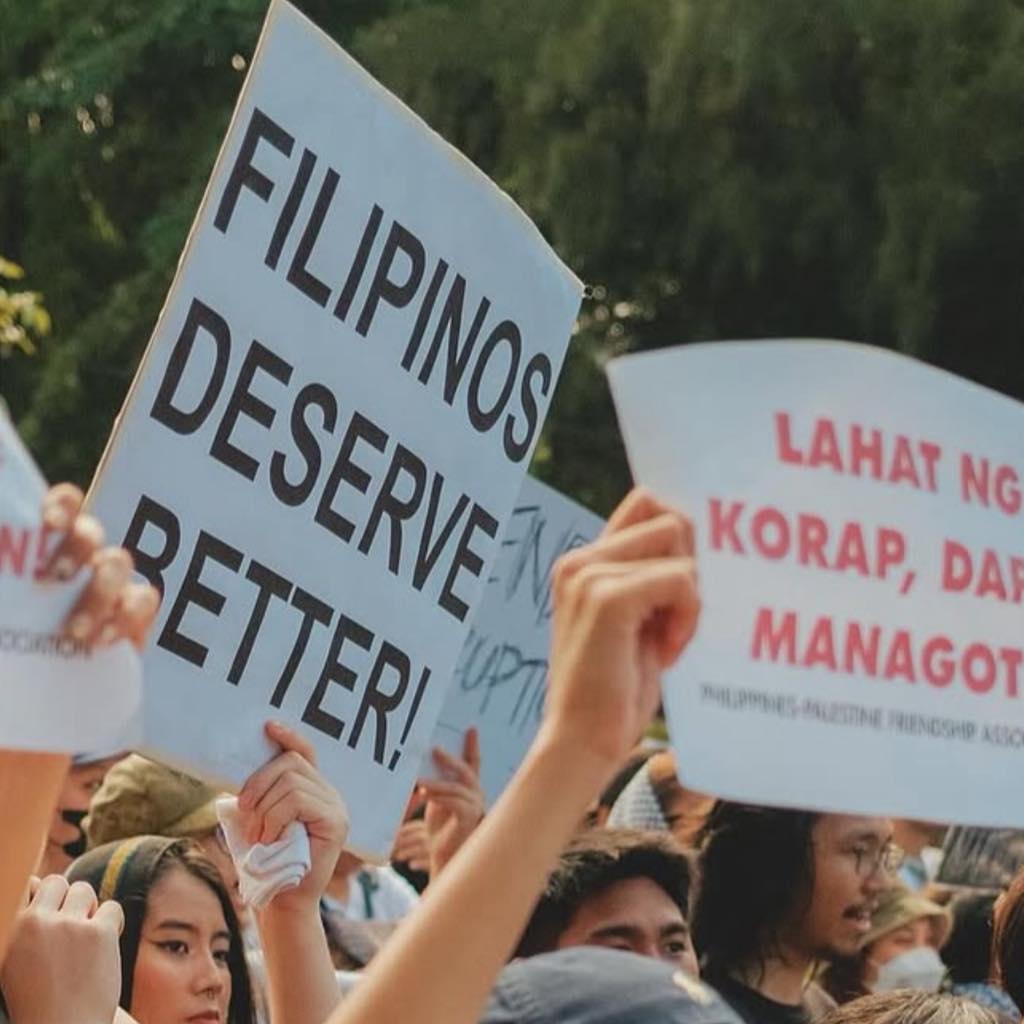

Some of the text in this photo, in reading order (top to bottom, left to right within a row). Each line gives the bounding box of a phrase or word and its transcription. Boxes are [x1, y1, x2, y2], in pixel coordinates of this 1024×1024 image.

[212, 107, 552, 463] FILIPINOS
[149, 297, 500, 623] DESERVE
[707, 497, 917, 595] KORAP,
[774, 412, 1023, 515] LAHAT NG
[121, 494, 432, 772] BETTER!
[749, 606, 1023, 699] MANAGOT
